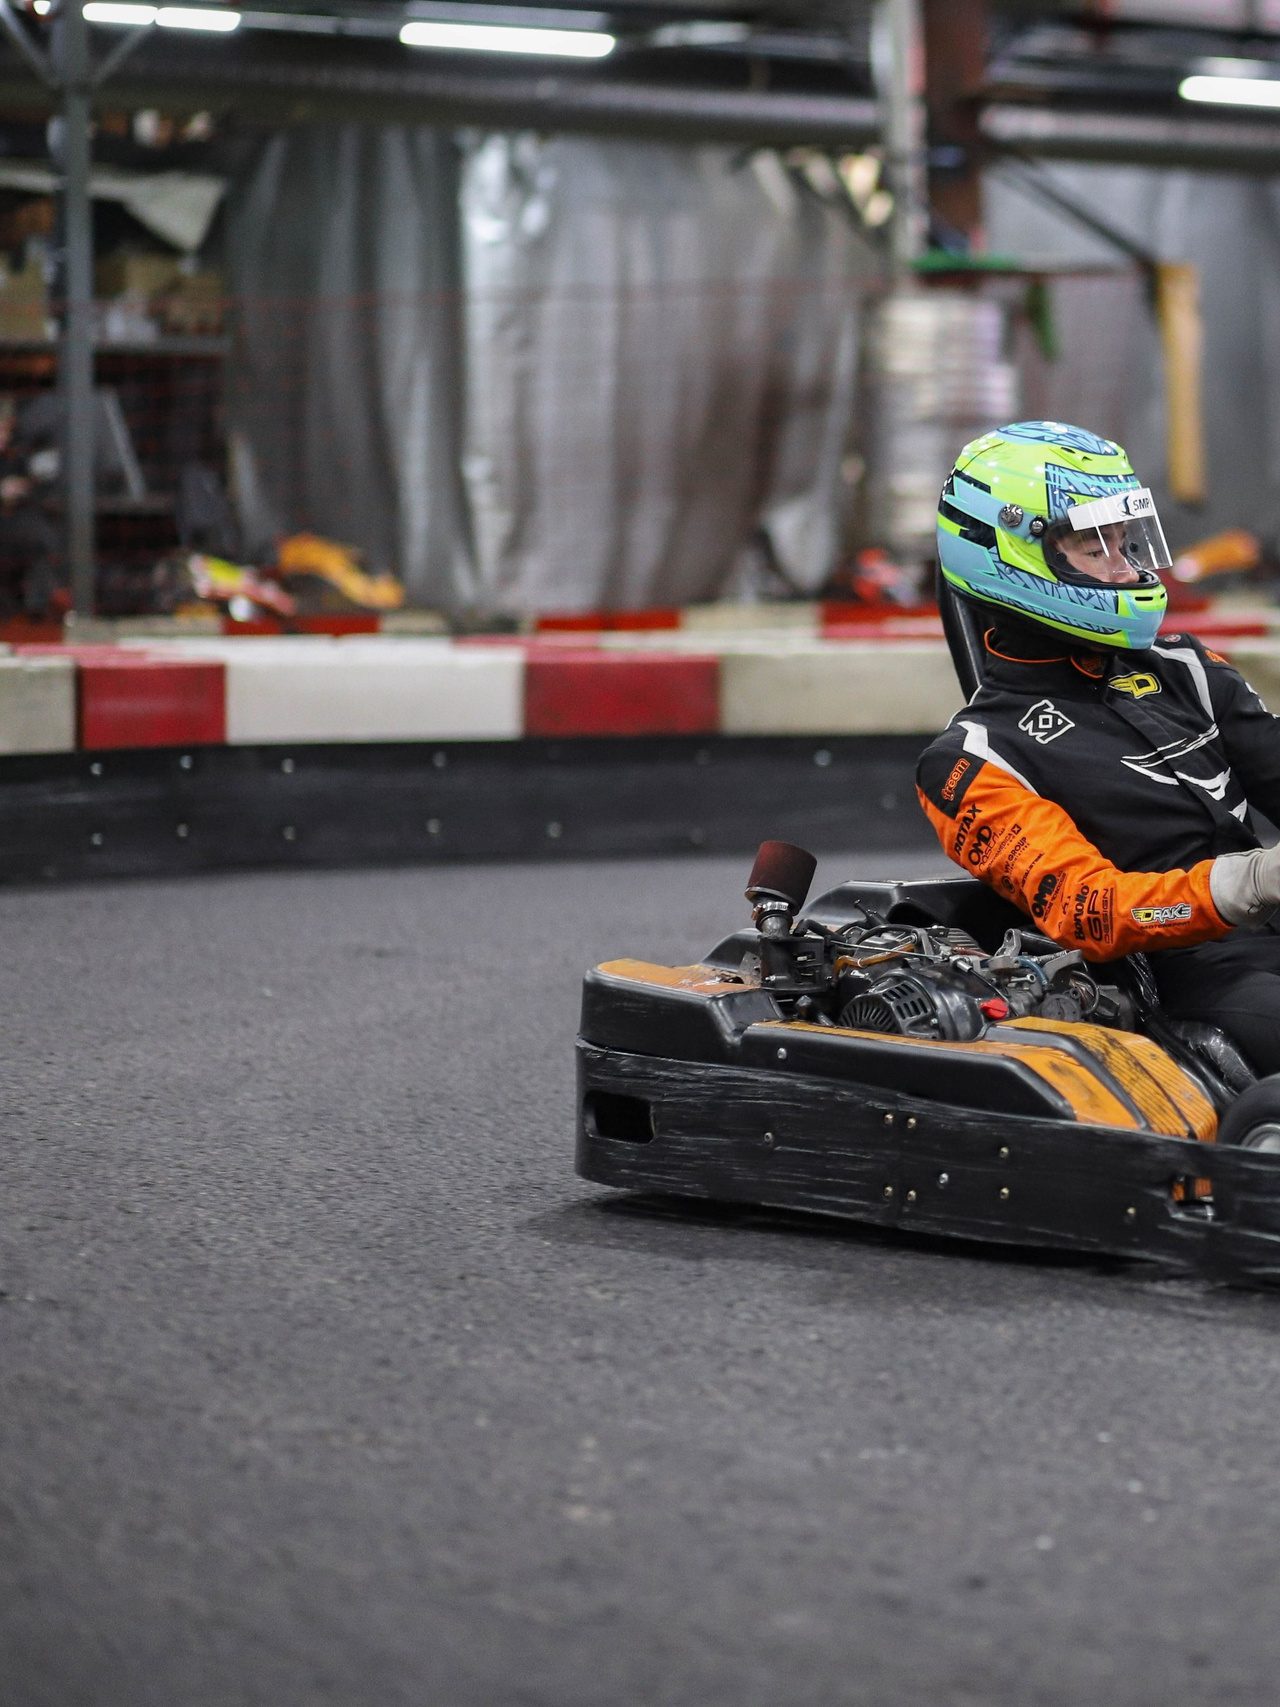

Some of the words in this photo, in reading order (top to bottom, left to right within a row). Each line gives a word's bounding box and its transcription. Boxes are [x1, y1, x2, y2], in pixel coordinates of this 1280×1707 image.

[941, 757, 971, 802] freem
[954, 803, 982, 856] ROTAX
[968, 825, 992, 866] OMD
[1008, 836, 1027, 862] GROUP
[1102, 888, 1110, 944] DESIGN
[1131, 903, 1192, 924] DRAKE
[1140, 921, 1191, 931] MOTORSPORT
